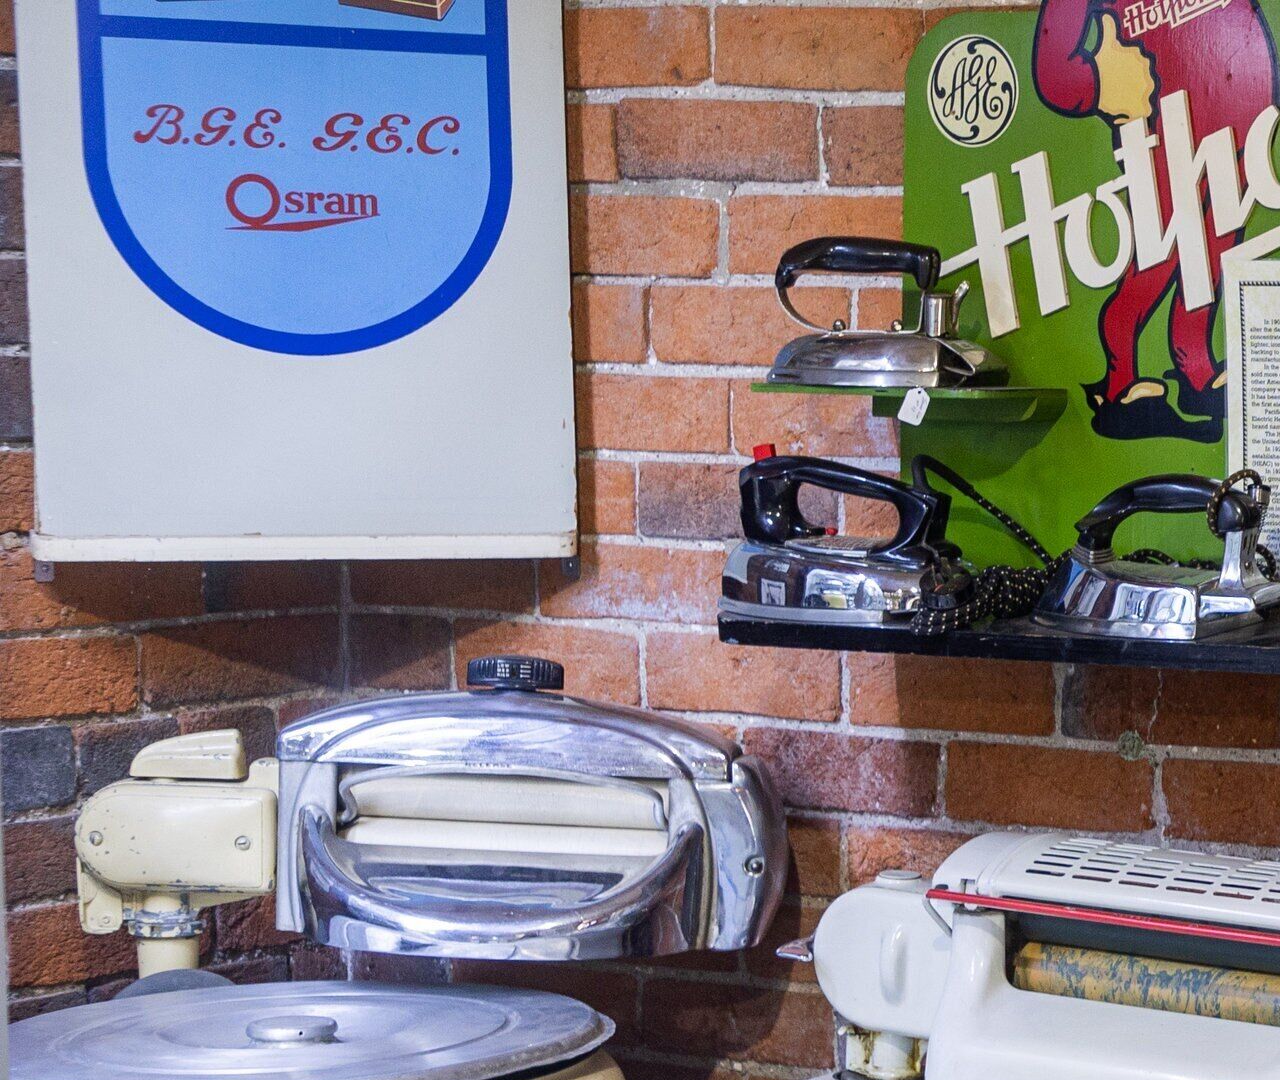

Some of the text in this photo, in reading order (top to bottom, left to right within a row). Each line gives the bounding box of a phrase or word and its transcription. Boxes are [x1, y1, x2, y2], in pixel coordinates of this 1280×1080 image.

[1124, 0, 1231, 37] Hotpo
[133, 104, 460, 156] B.G.E. G.E.C.
[225, 173, 381, 231] Osram
